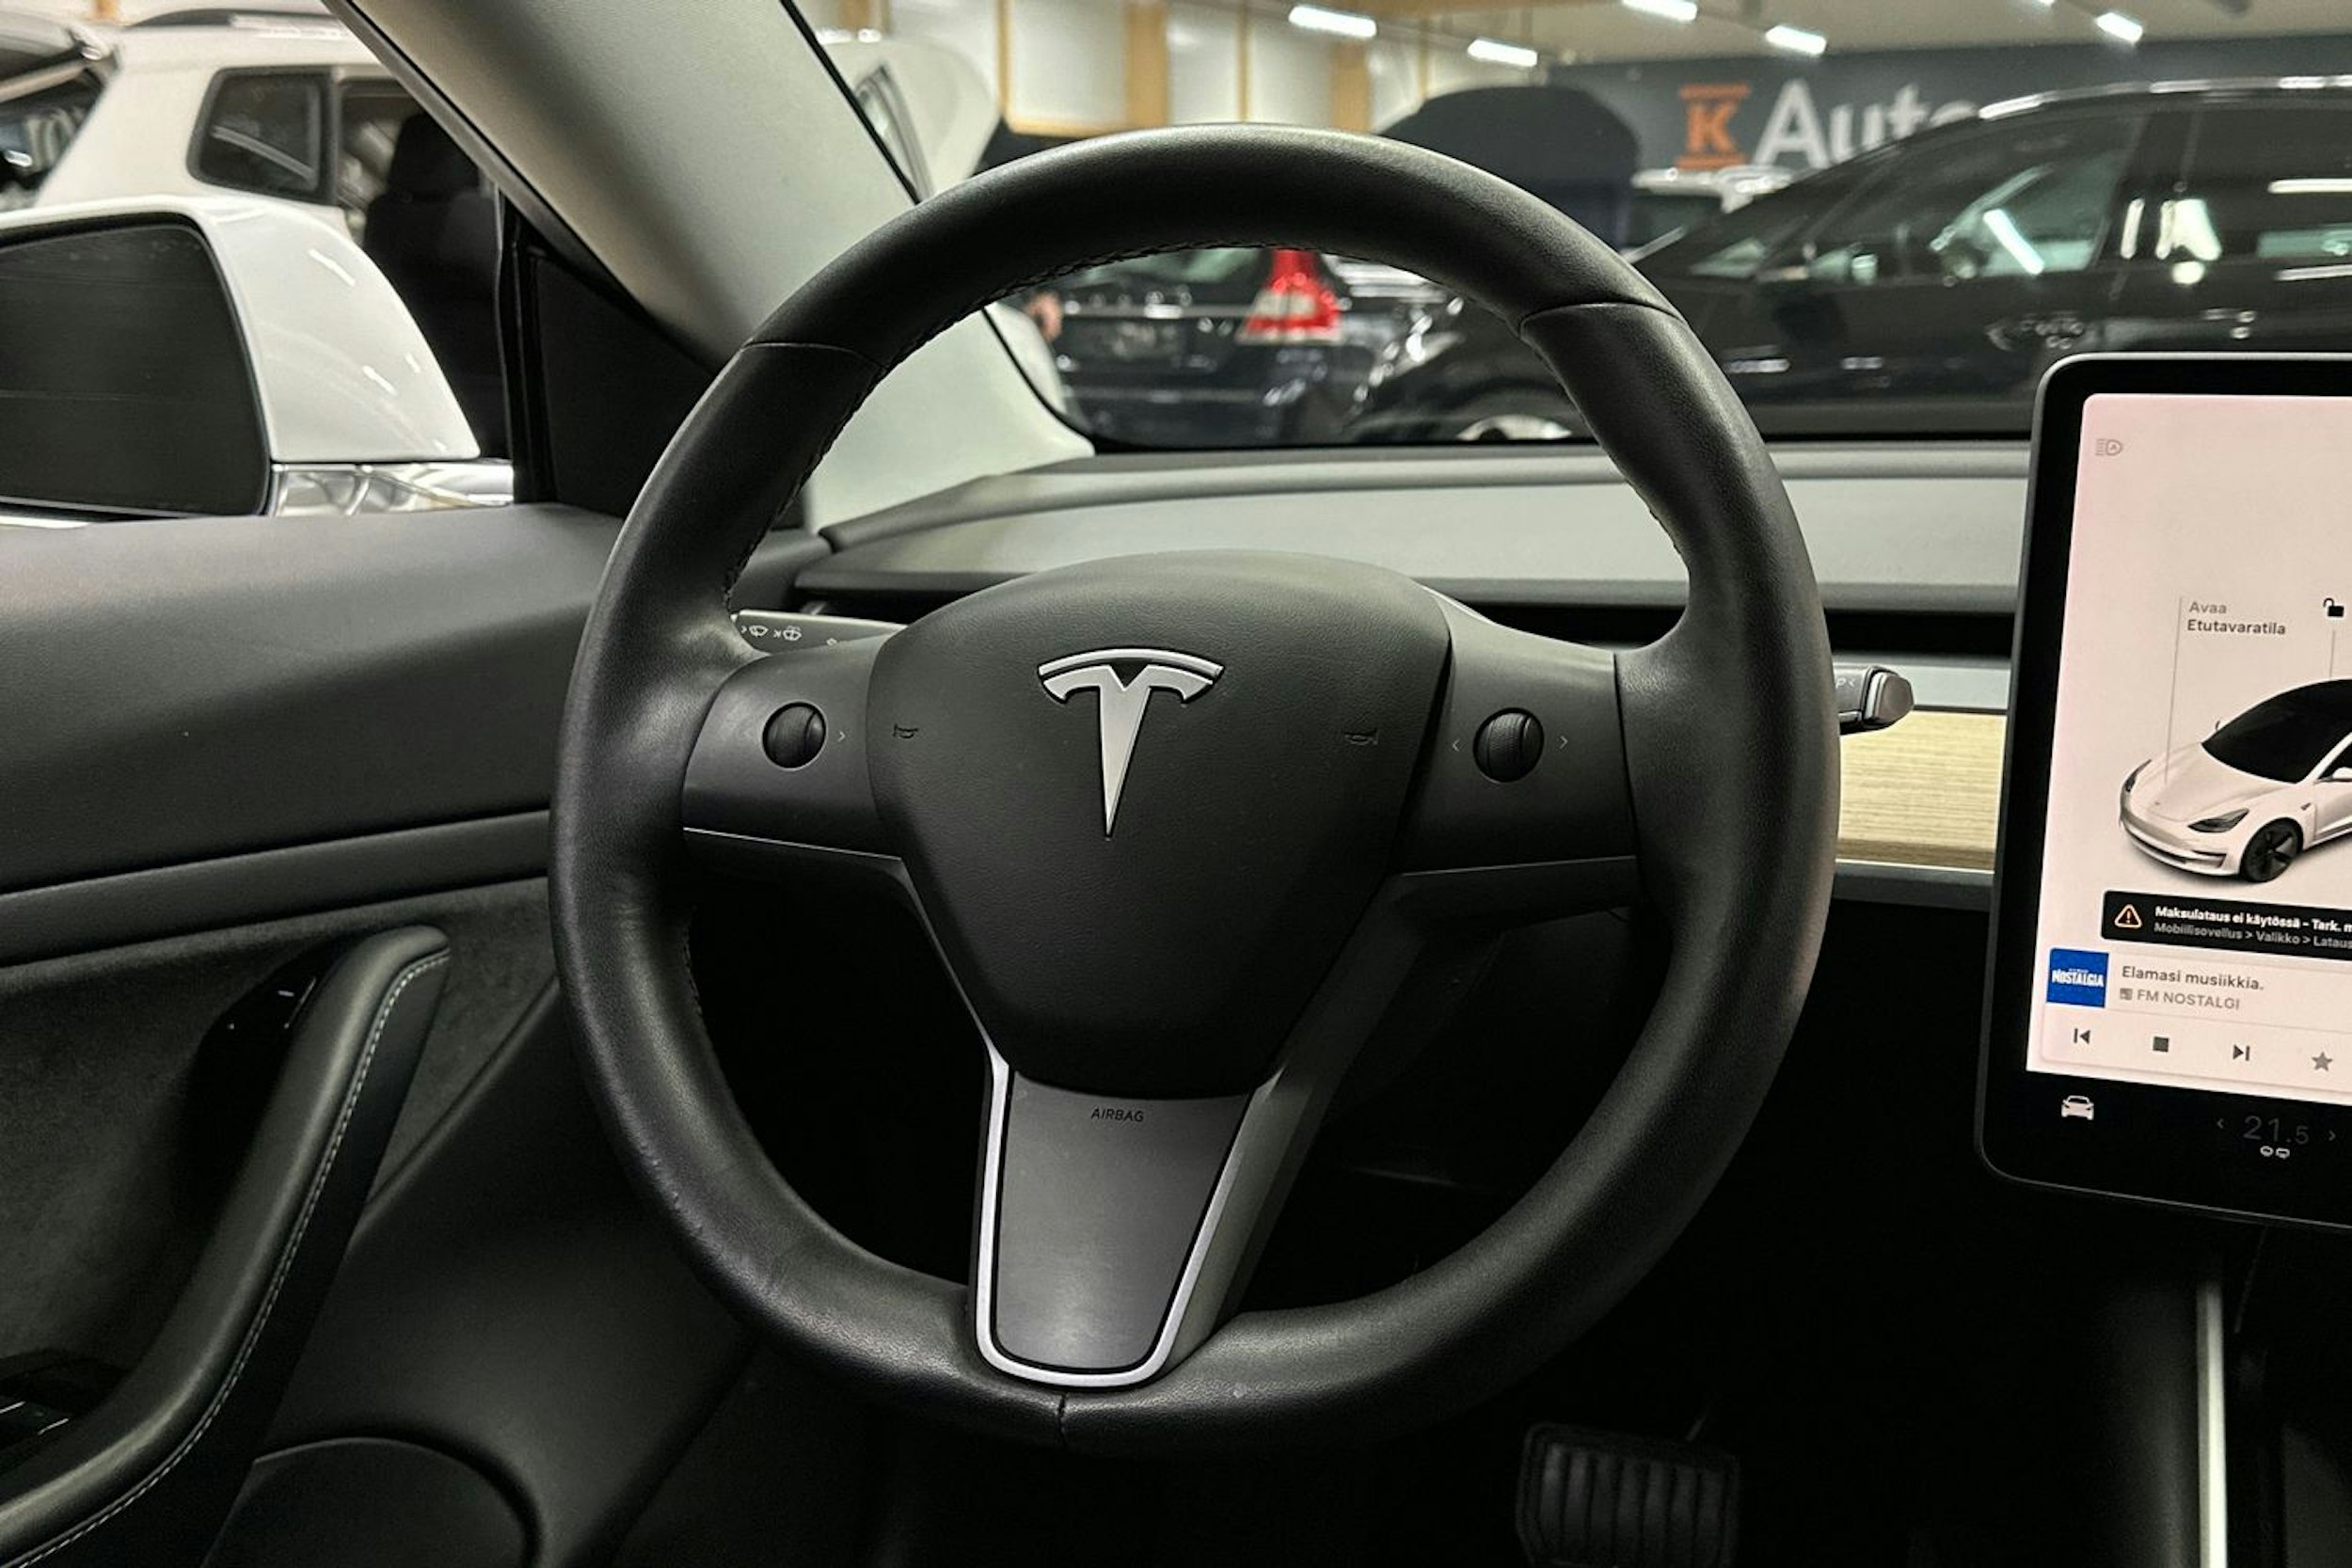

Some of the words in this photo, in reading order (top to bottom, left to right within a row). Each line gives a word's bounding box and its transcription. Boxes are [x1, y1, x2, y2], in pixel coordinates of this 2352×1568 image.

[2189, 601, 2227, 614] Avaa
[2187, 619, 2286, 635] Etutavaratila
[2155, 906, 2231, 923] Maksulataus
[2233, 912, 2244, 924] ei
[2246, 912, 2300, 928] käytössä
[2311, 918, 2342, 932] Tark.
[2153, 922, 2243, 940] Mobiilisovellus
[2256, 930, 2301, 945] Valikko
[2122, 965, 2181, 982] Elamasi
[2185, 974, 2265, 990] musiikkia.
[2137, 989, 2159, 1003] FM
[2163, 990, 2240, 1010] NOSTALGI
[1091, 1108, 1144, 1122] AIRBAG
[2243, 1116, 2309, 1145] 21.5
